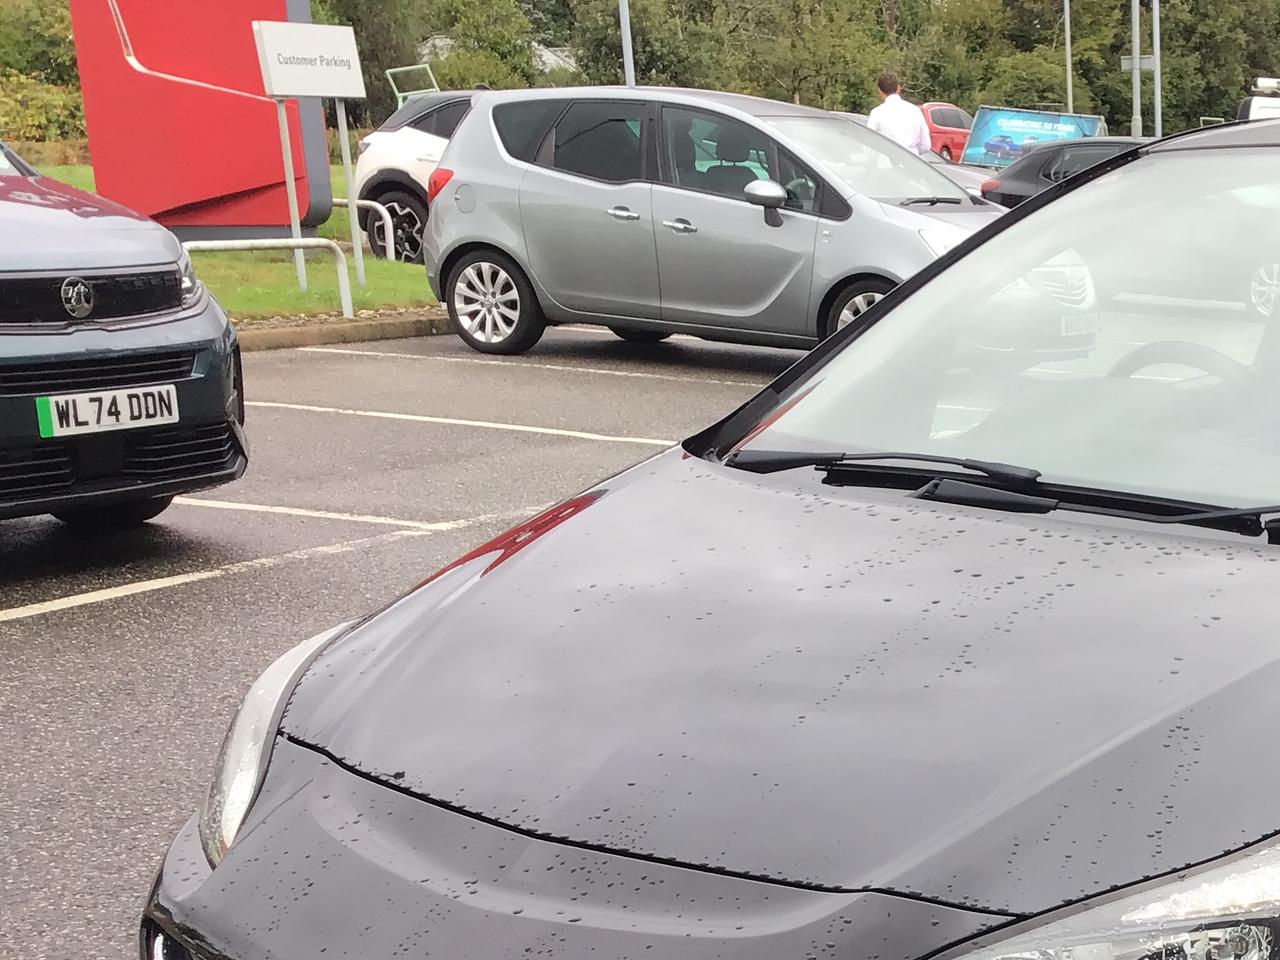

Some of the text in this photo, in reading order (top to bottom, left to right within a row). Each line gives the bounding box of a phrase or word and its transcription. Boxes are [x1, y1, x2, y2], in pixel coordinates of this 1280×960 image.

[277, 52, 352, 70] Customer Parking
[55, 389, 173, 428] WL74 DDN
